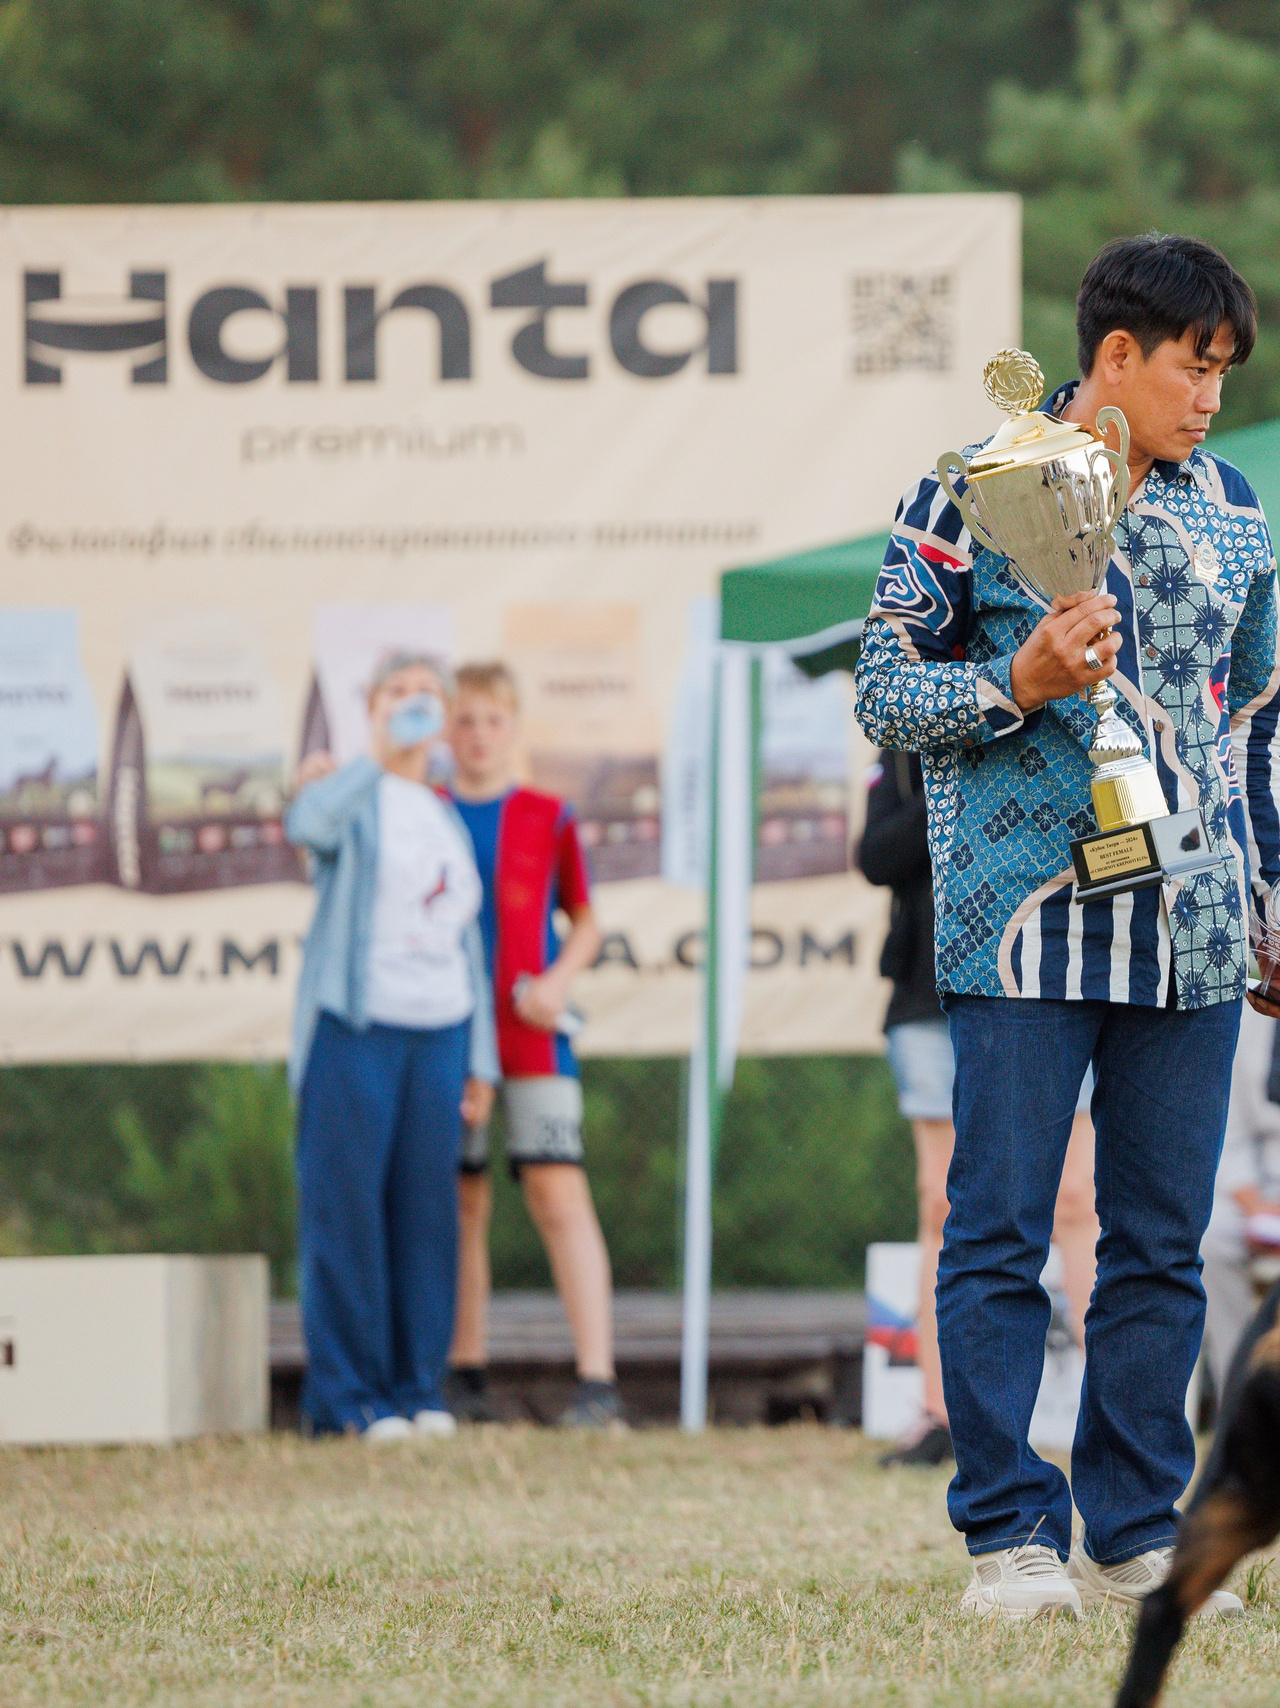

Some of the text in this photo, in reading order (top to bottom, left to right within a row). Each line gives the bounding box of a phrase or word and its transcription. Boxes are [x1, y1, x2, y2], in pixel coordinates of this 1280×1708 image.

[23, 257, 741, 386] Hanta
[240, 421, 526, 465] premium
[1113, 847, 1133, 857] FEMALE
